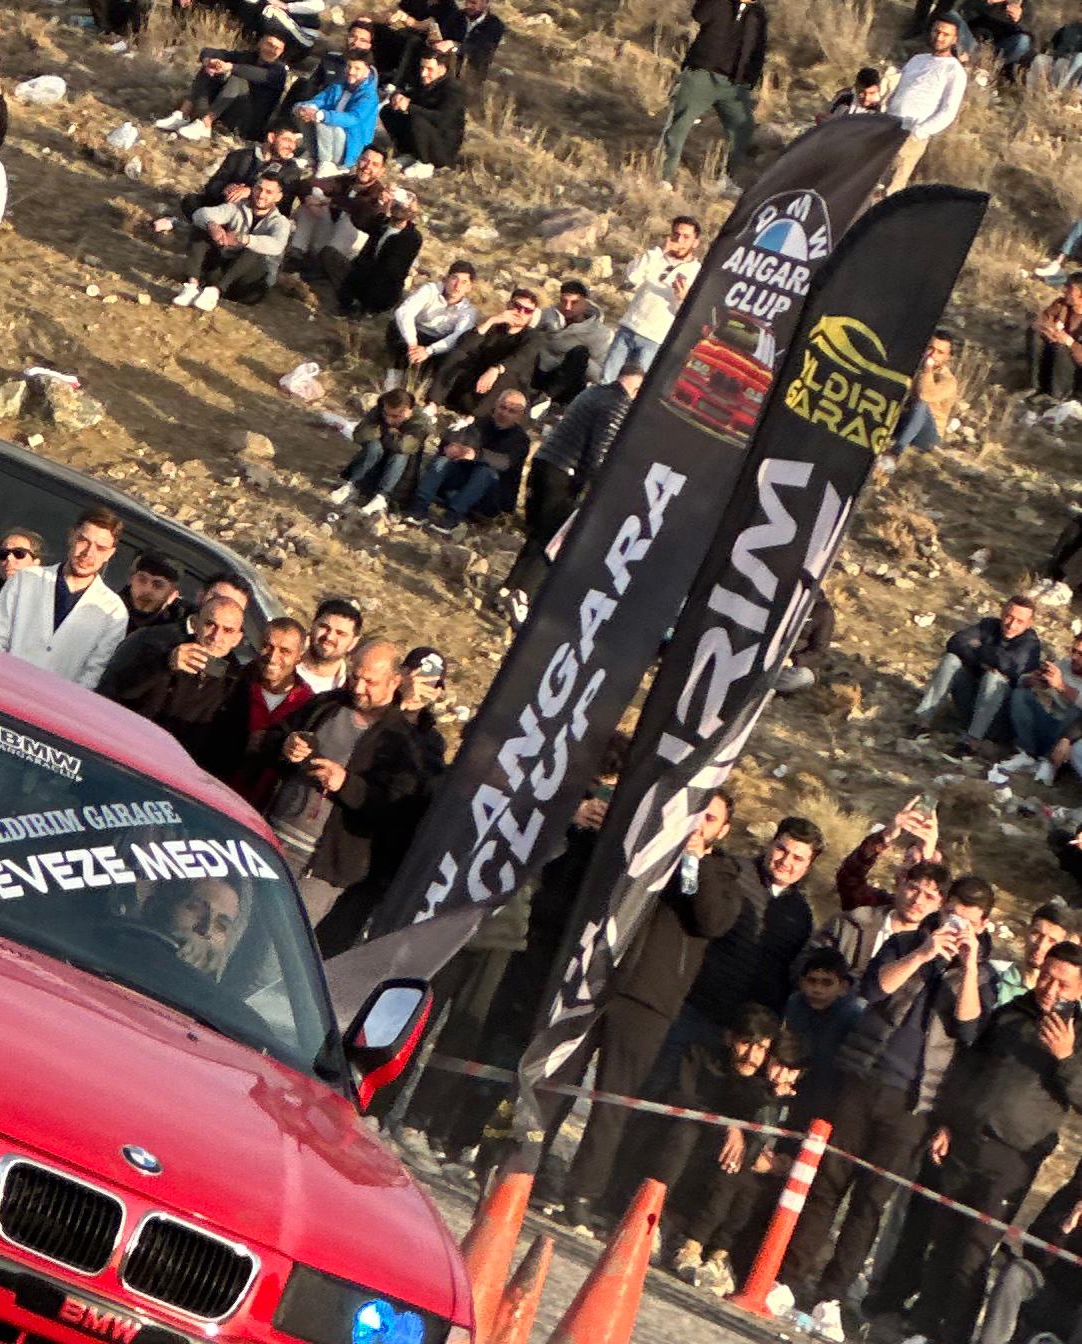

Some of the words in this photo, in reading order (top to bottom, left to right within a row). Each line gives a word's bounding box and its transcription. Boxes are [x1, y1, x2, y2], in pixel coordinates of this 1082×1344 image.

[721, 246, 811, 297] ANGAR
[724, 280, 792, 320] CLUP
[784, 378, 896, 455] GARAG
[470, 462, 687, 855] ANGARA
[467, 668, 606, 902] CLUP
[82, 800, 182, 830] GARAGE
[130, 839, 280, 881] MEDYA
[59, 1296, 142, 1344] BMW
